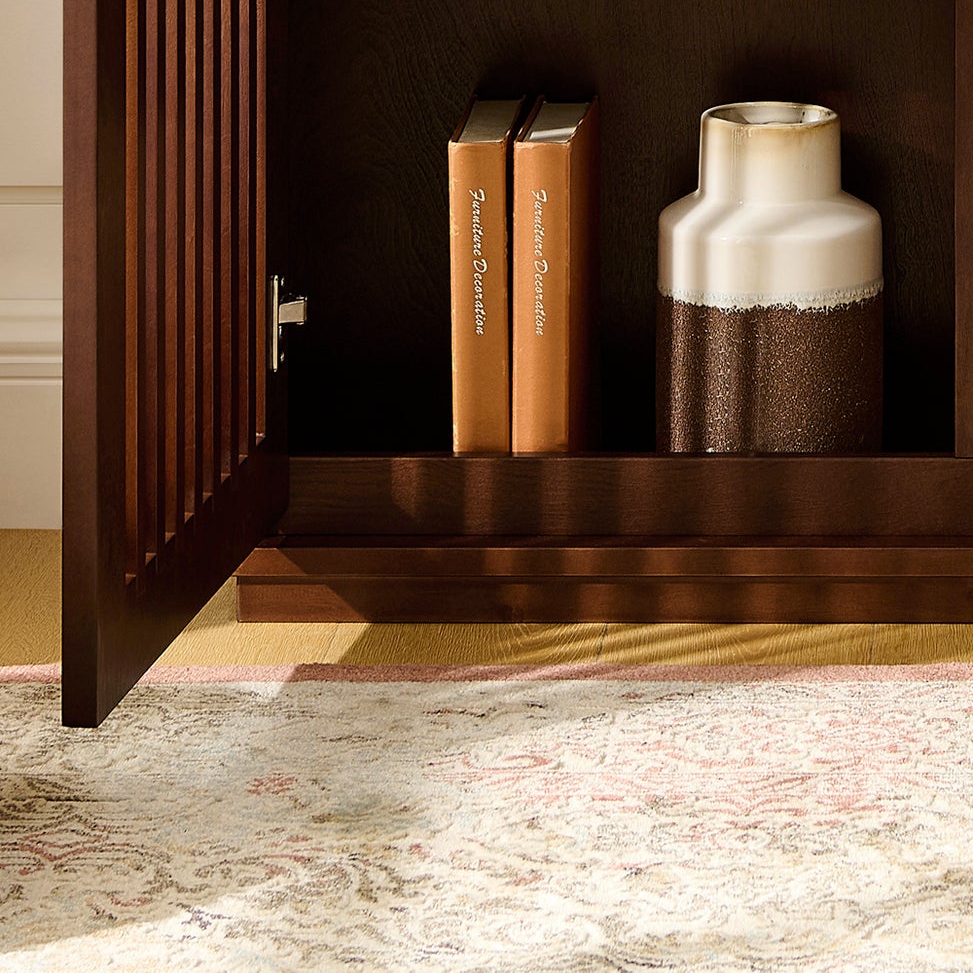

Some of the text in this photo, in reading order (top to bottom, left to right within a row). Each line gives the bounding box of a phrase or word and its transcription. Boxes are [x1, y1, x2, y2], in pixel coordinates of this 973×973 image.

[469, 188, 488, 336] Furniture Decoration
[531, 189, 549, 337] Furniture Decoration
